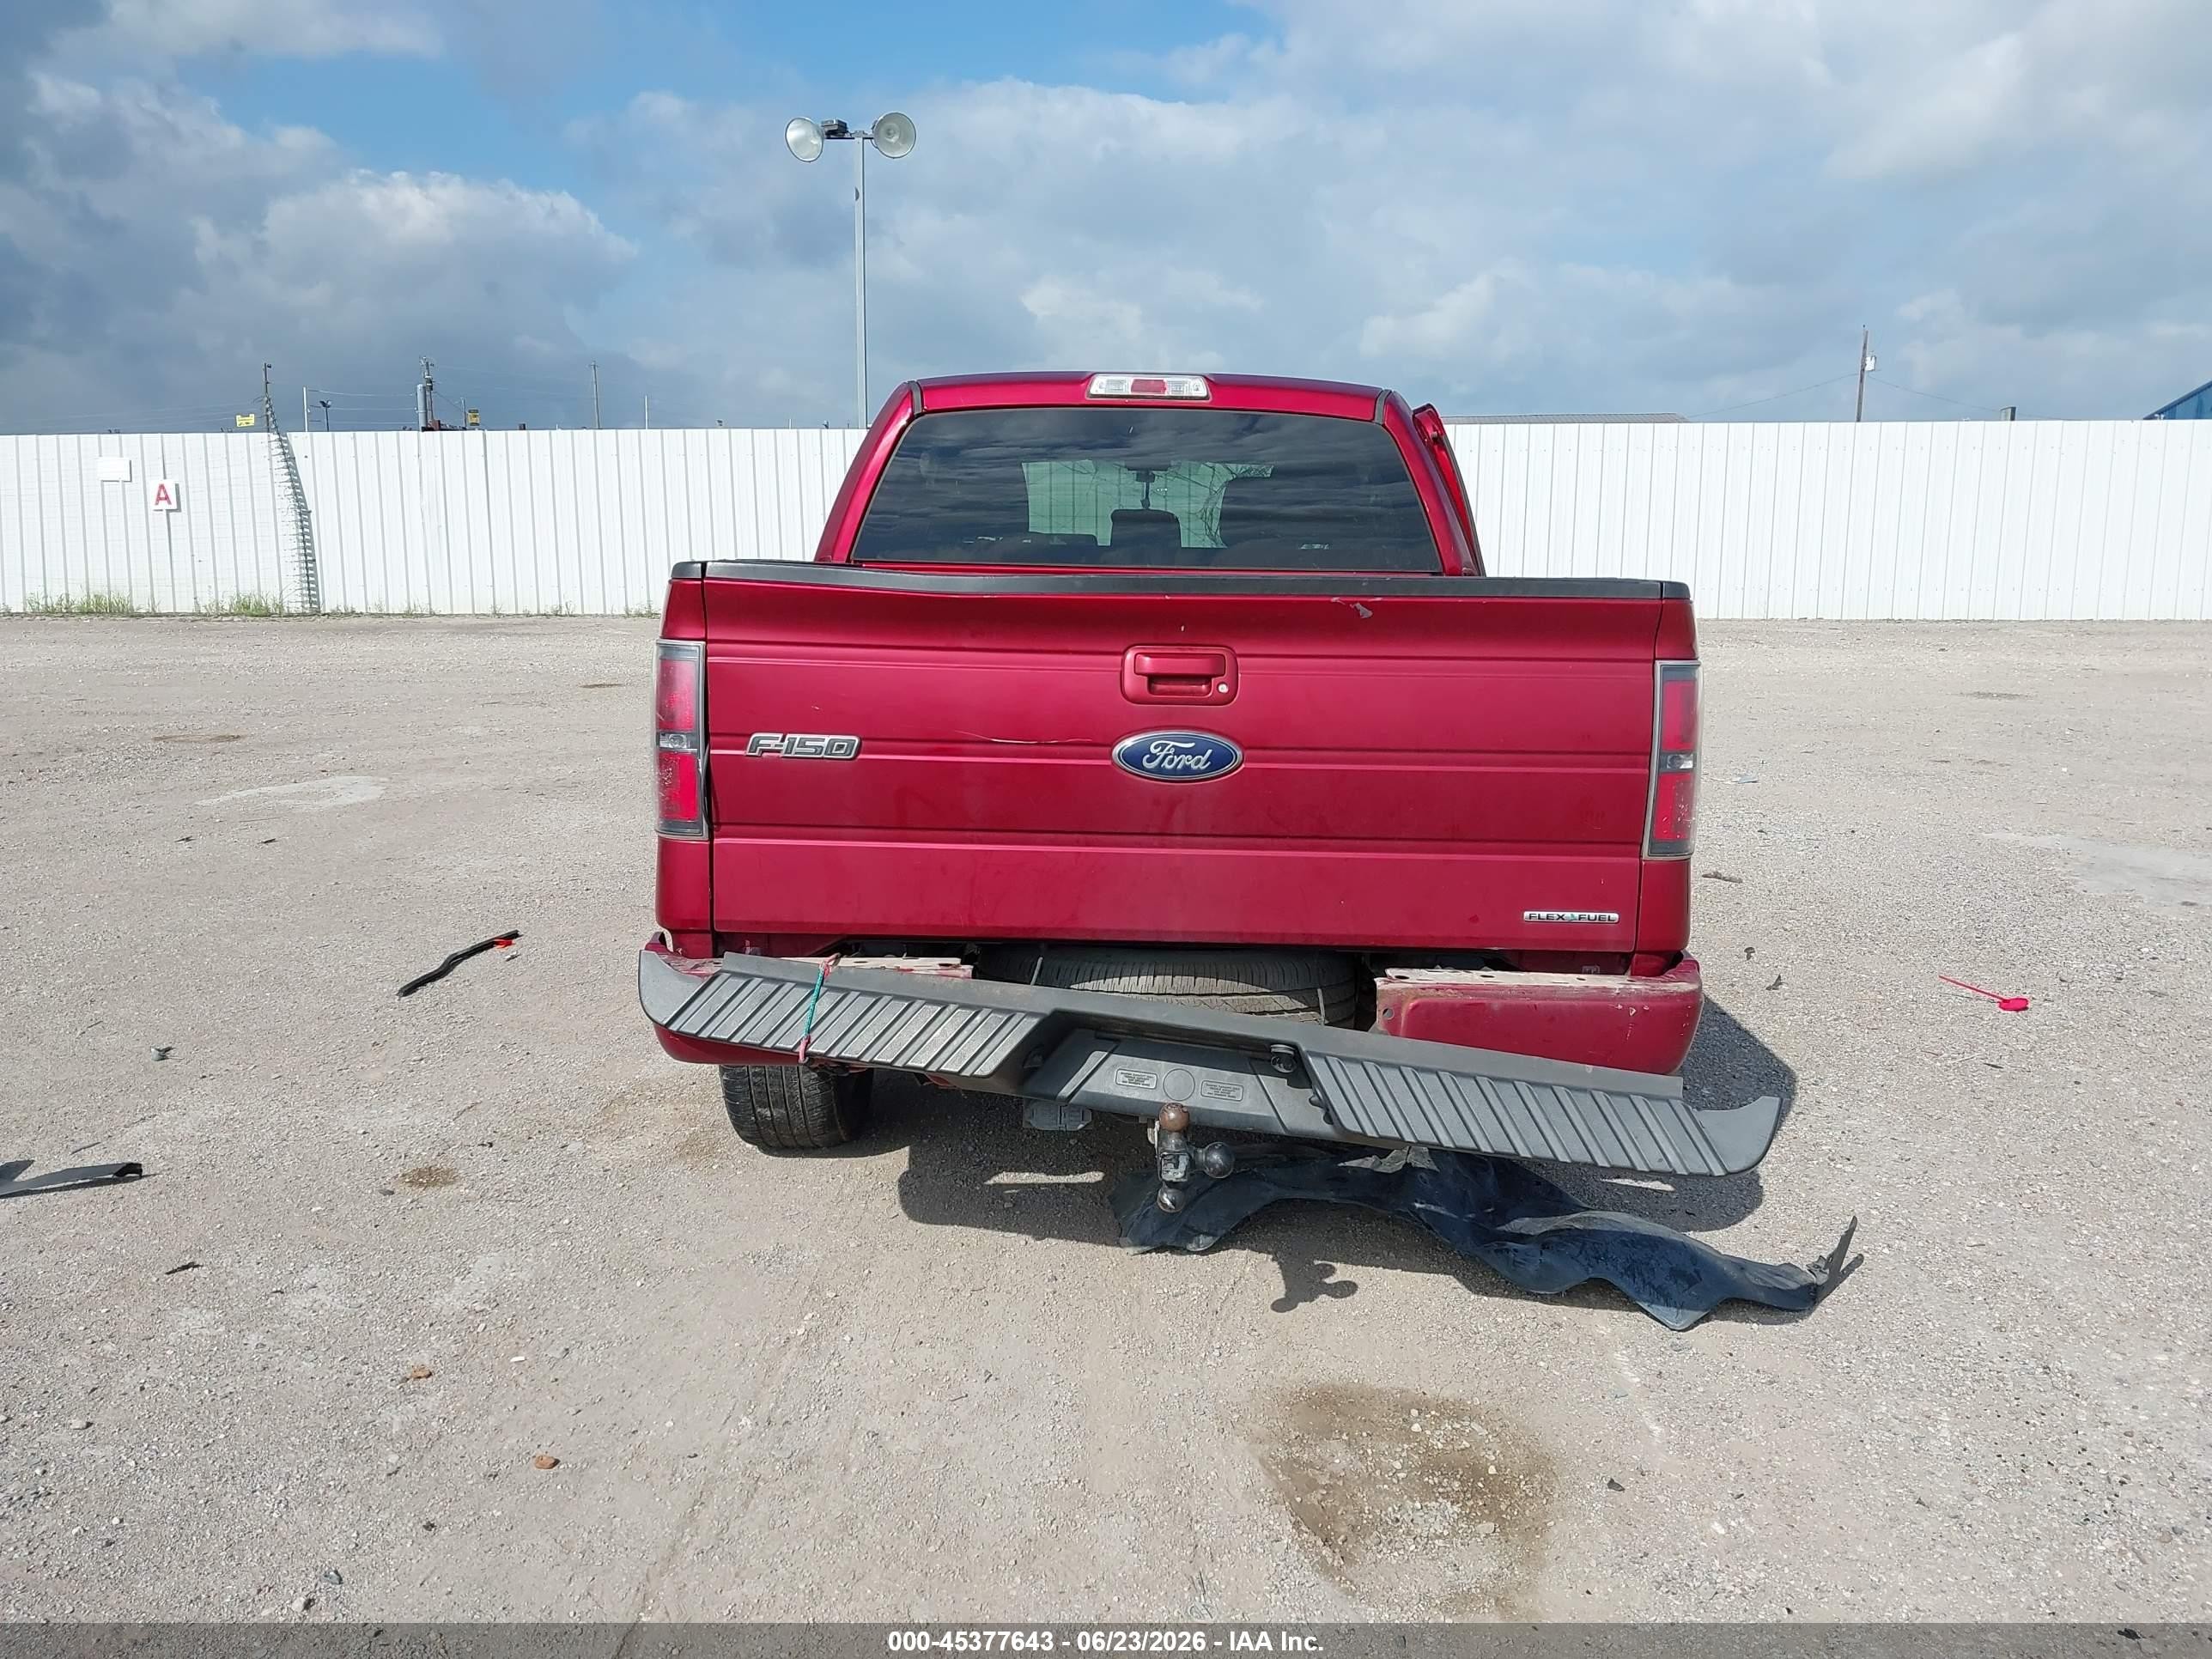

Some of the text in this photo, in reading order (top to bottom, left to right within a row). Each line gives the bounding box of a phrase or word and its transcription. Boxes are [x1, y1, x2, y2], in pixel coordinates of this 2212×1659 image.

[155, 483, 172, 506] A
[745, 732, 860, 760] F-150
[1142, 740, 1213, 770] Ford
[1528, 913, 1617, 922] FLEX FUEL
